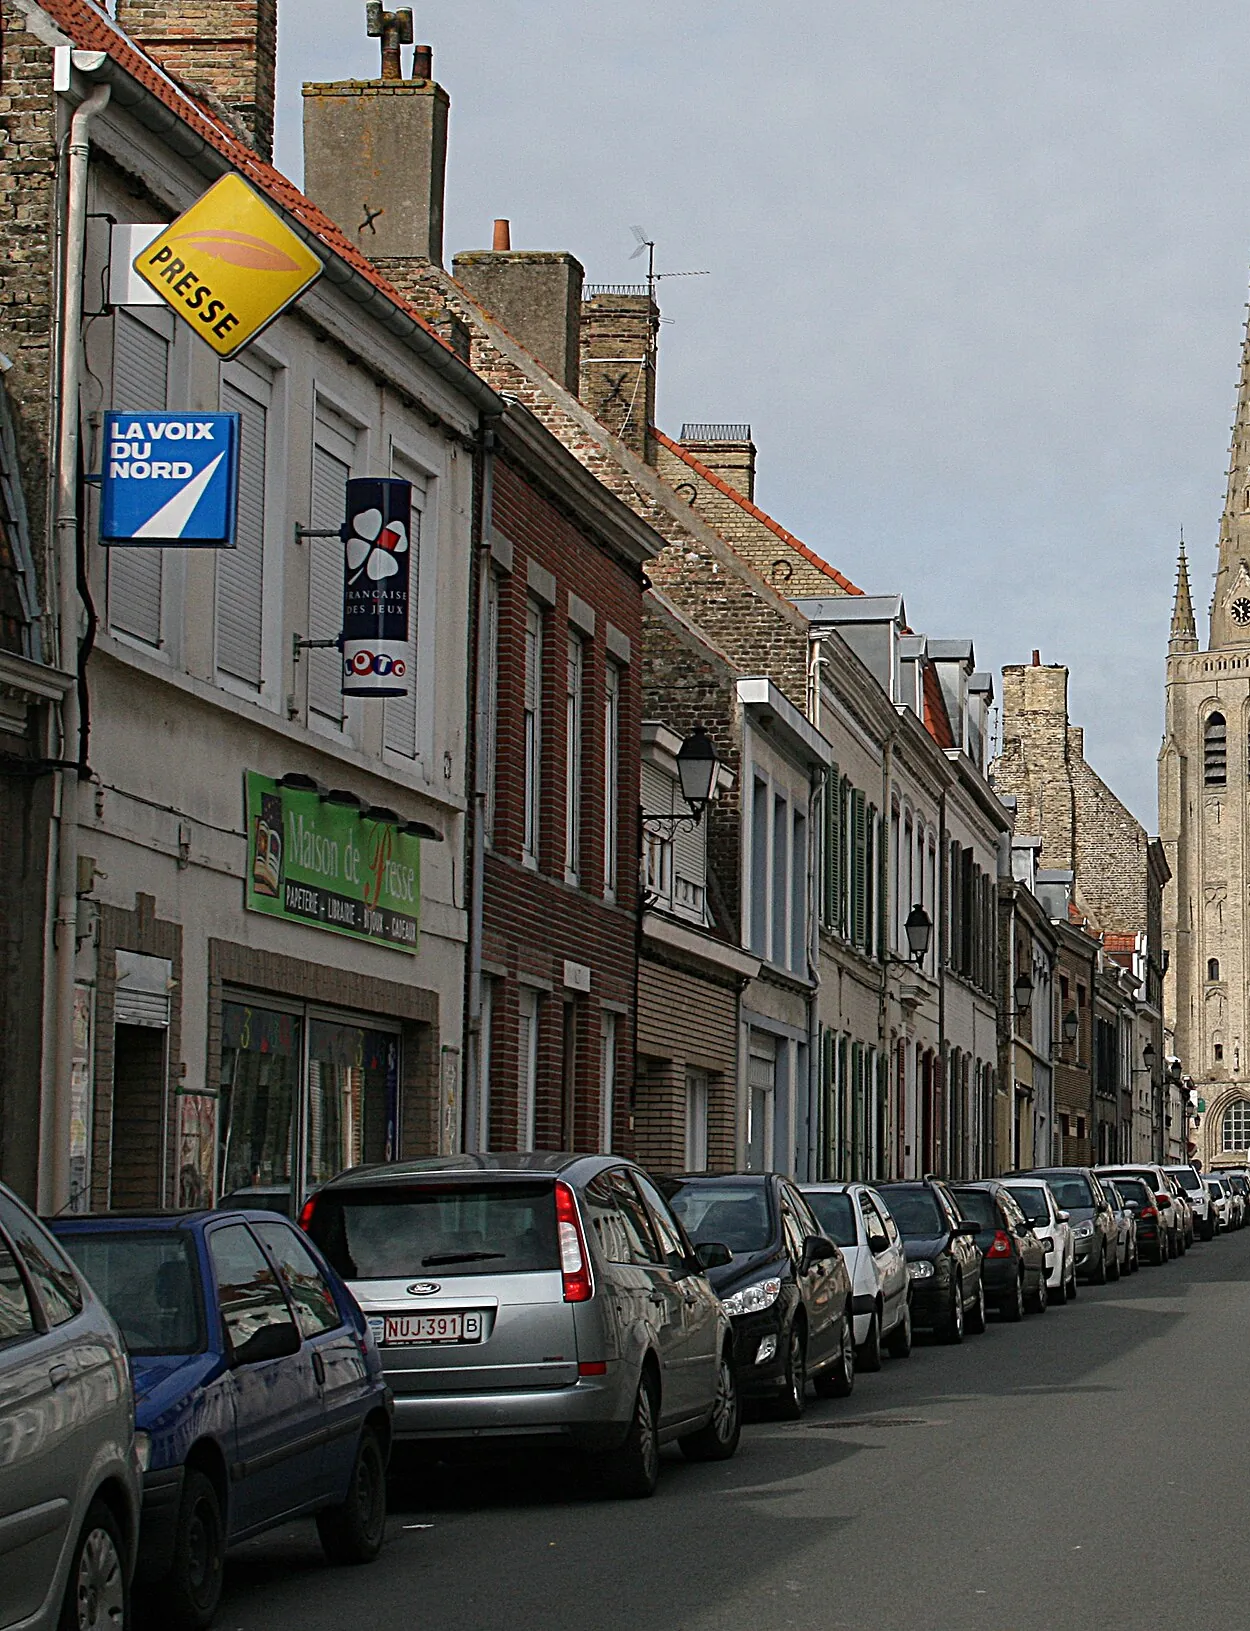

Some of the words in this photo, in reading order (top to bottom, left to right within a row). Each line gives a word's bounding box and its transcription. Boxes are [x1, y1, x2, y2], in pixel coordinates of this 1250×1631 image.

[149, 245, 240, 340] PRESSE
[111, 422, 145, 440] LA
[147, 422, 214, 440] VOIX
[110, 442, 151, 460] DU
[109, 461, 193, 480] NORD
[347, 604, 365, 615] DES
[371, 604, 403, 615] JEUX
[344, 650, 406, 678] LOTO
[289, 811, 339, 878] Maison
[344, 828, 361, 885] de
[362, 823, 415, 911] Presse
[286, 884, 318, 914] PAPETERIE
[328, 897, 355, 925] LIBRAIRIE
[391, 916, 416, 941] CADEAUX
[466, 1318, 477, 1333] B
